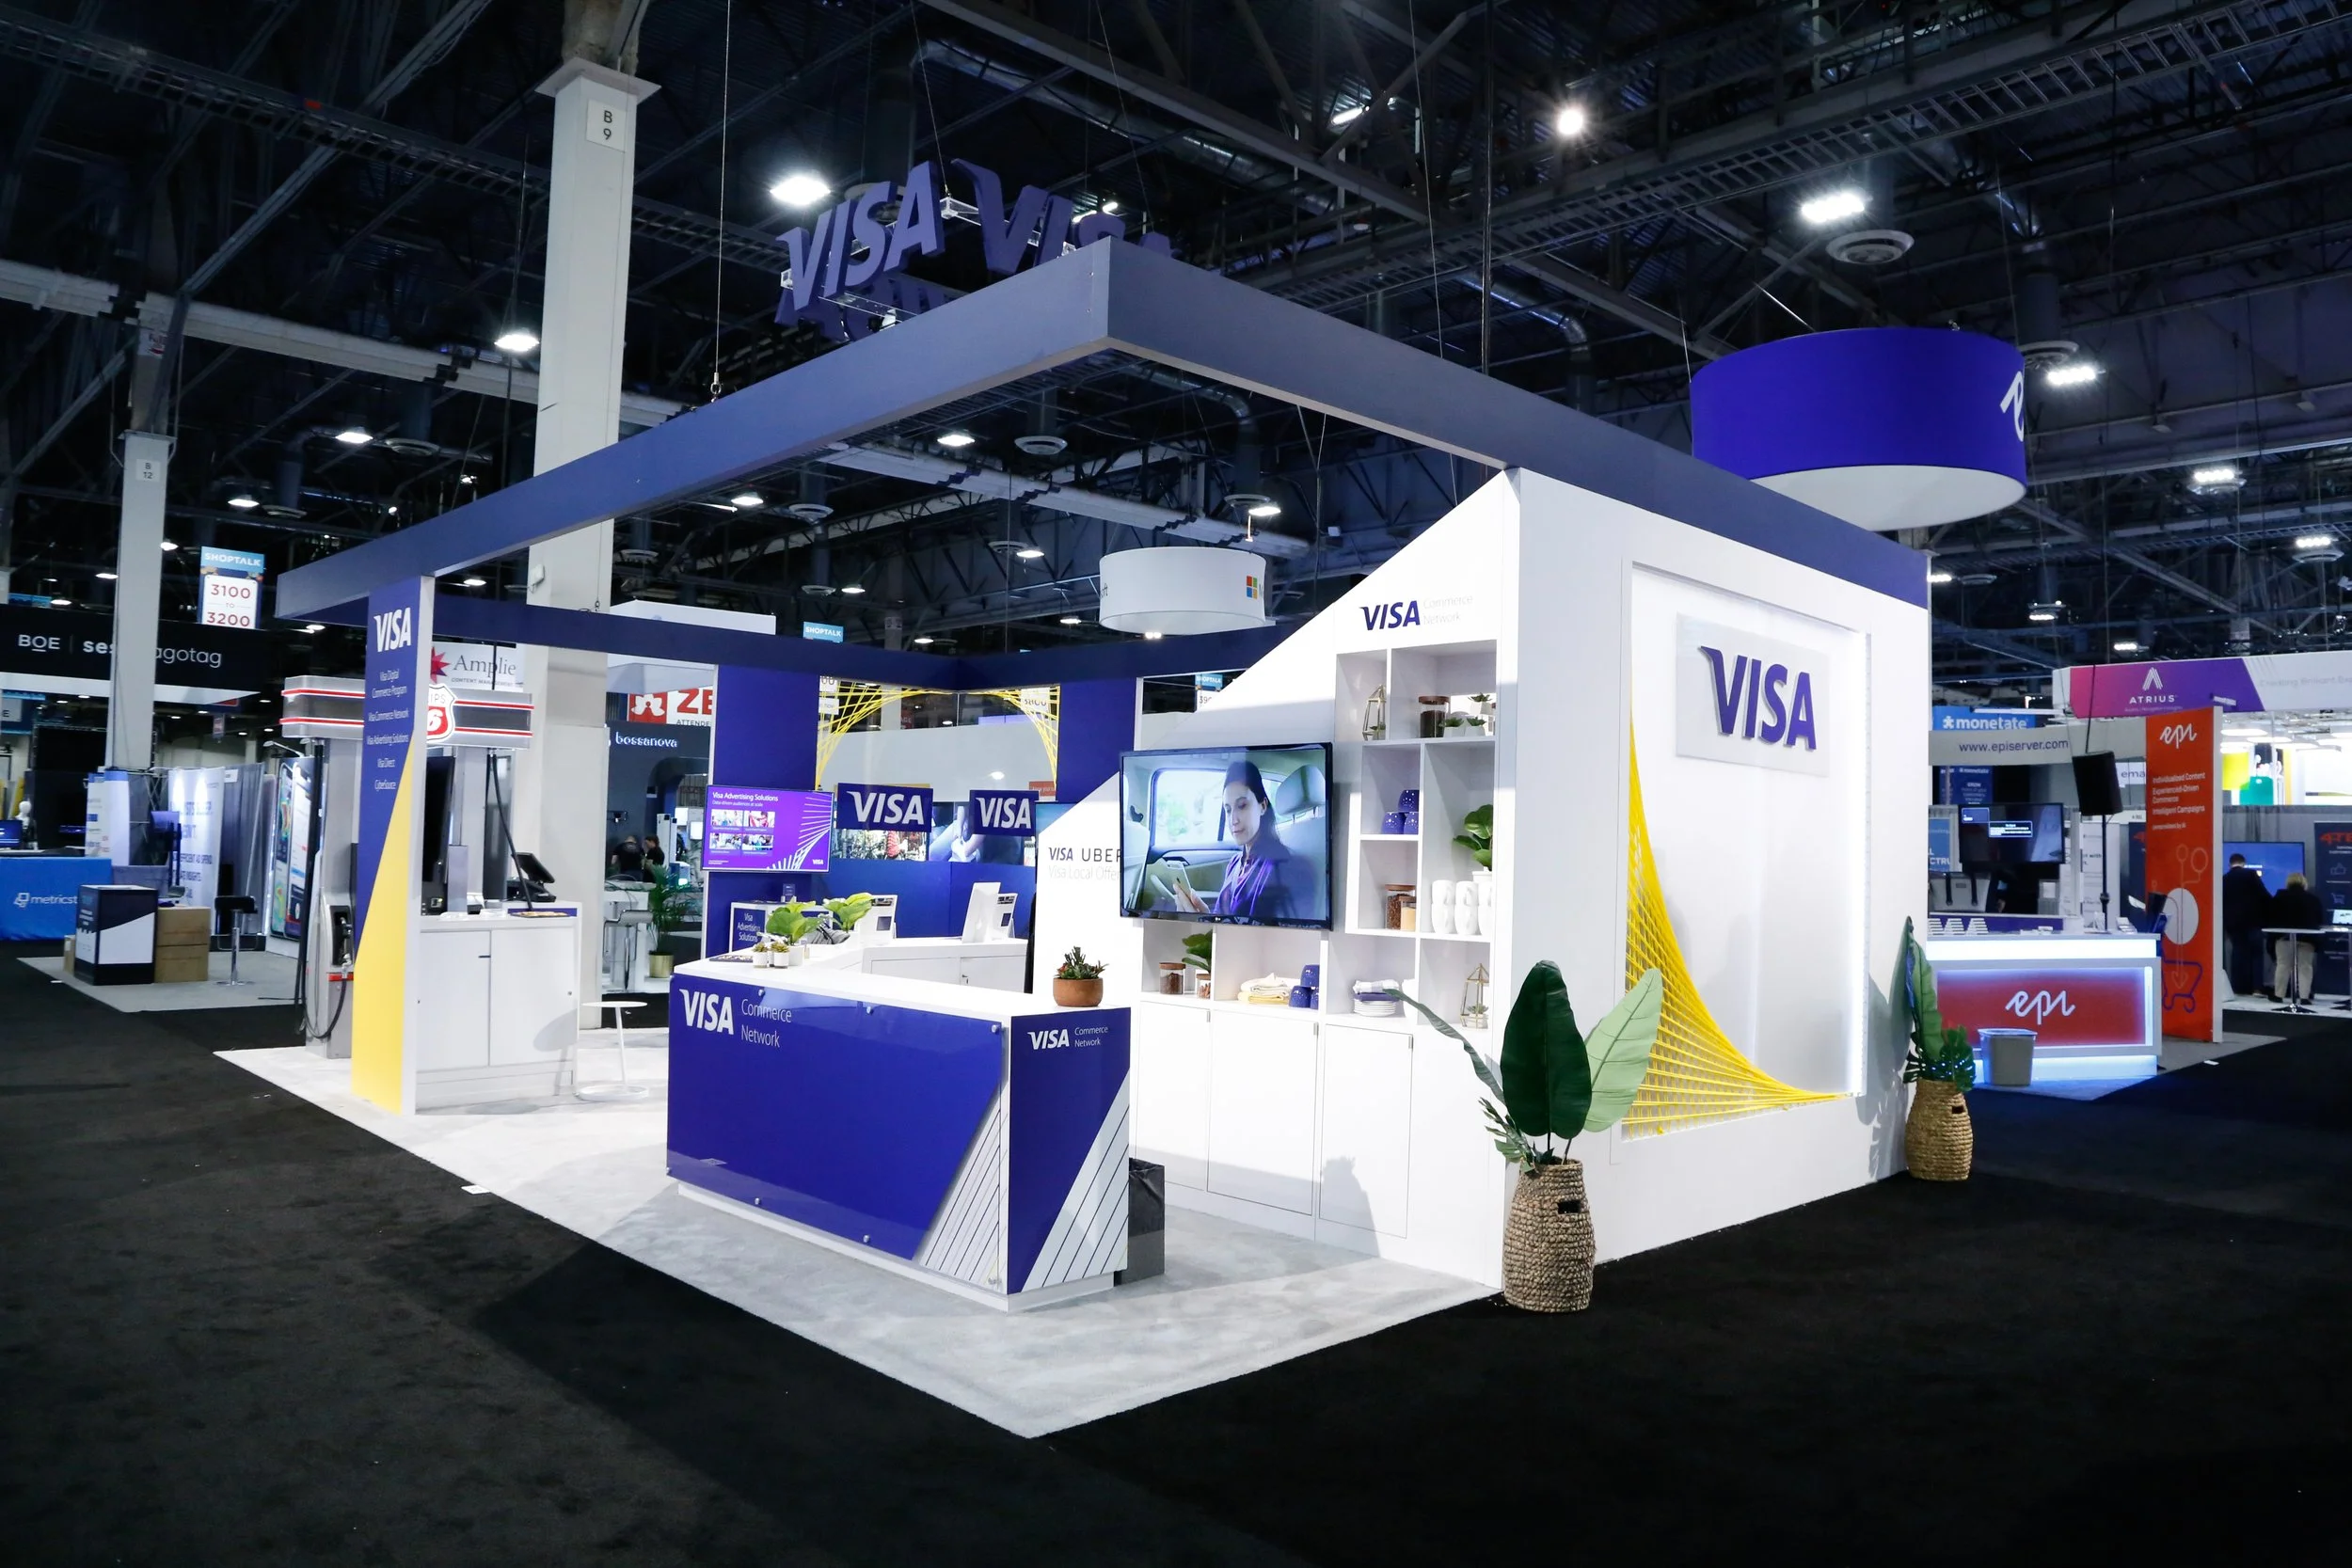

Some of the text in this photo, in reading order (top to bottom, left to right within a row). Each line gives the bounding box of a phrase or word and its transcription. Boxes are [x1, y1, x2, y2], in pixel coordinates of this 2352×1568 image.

[603, 110, 612, 124] B
[602, 128, 612, 141] 9
[776, 161, 945, 311] VISA
[204, 552, 262, 566] SHOPTALK
[211, 584, 251, 598] 3100
[207, 612, 250, 626] 3200
[1359, 595, 1473, 630] VISA Commerce
[1423, 611, 1461, 625] Network
[373, 608, 411, 653] VISA
[805, 626, 842, 637] SHOPTALK
[18, 634, 60, 651] BOE
[1699, 645, 1817, 751] VISA
[2129, 694, 2175, 704] ATRIUS
[1956, 717, 2027, 730] monetate
[615, 732, 678, 748] bossanova
[1959, 739, 2069, 753] www.episerver.com
[2185, 772, 2205, 781] Content
[724, 792, 754, 801] Advertising
[847, 790, 924, 825] VISA
[975, 798, 1032, 830] VISA
[1048, 847, 1073, 861] VISA
[1048, 865, 1066, 879] Visa
[1069, 865, 1093, 879] Local
[738, 923, 760, 931] Advertising
[679, 989, 792, 1035] VISA Commerce
[741, 1024, 781, 1048] Network
[1027, 1025, 1108, 1050] VISA Commerce
[1074, 1037, 1101, 1048] Network
